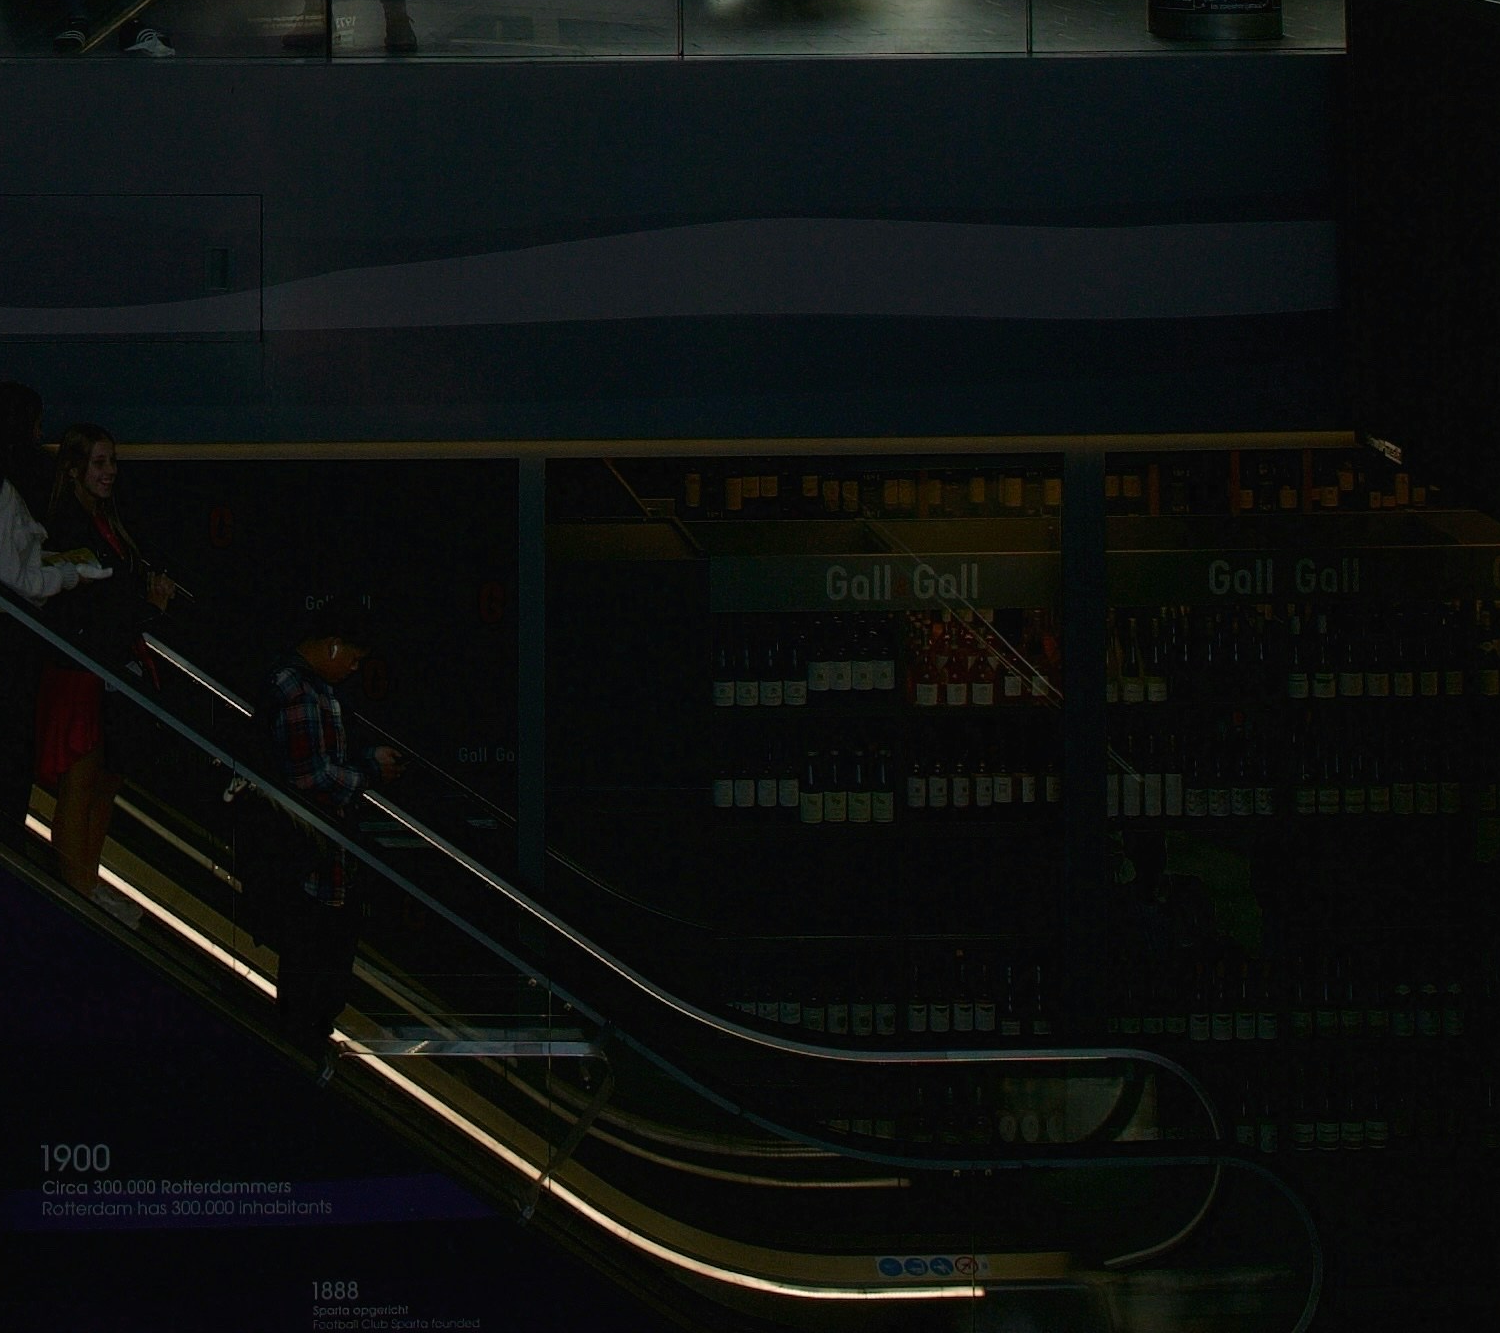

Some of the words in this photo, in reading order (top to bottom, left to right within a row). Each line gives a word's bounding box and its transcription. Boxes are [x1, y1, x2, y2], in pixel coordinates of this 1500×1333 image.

[826, 563, 892, 601] Gall
[912, 562, 979, 601] Gall
[39, 1143, 111, 1172] 1900
[41, 1180, 89, 1195] Circa
[93, 1179, 157, 1195] 300.000
[160, 1179, 292, 1195] Rotterdammers
[41, 1200, 133, 1216] Rotterdam
[137, 1200, 167, 1216] has
[171, 1199, 235, 1215] 300.000
[238, 1199, 332, 1215] inhabitants
[312, 1281, 359, 1301] 1888
[312, 1305, 350, 1318] Sparta
[352, 1305, 409, 1318] opgericht
[312, 1319, 359, 1330] Football
[361, 1318, 389, 1330] Club
[391, 1319, 429, 1331] Sparta
[431, 1318, 481, 1329] founded
